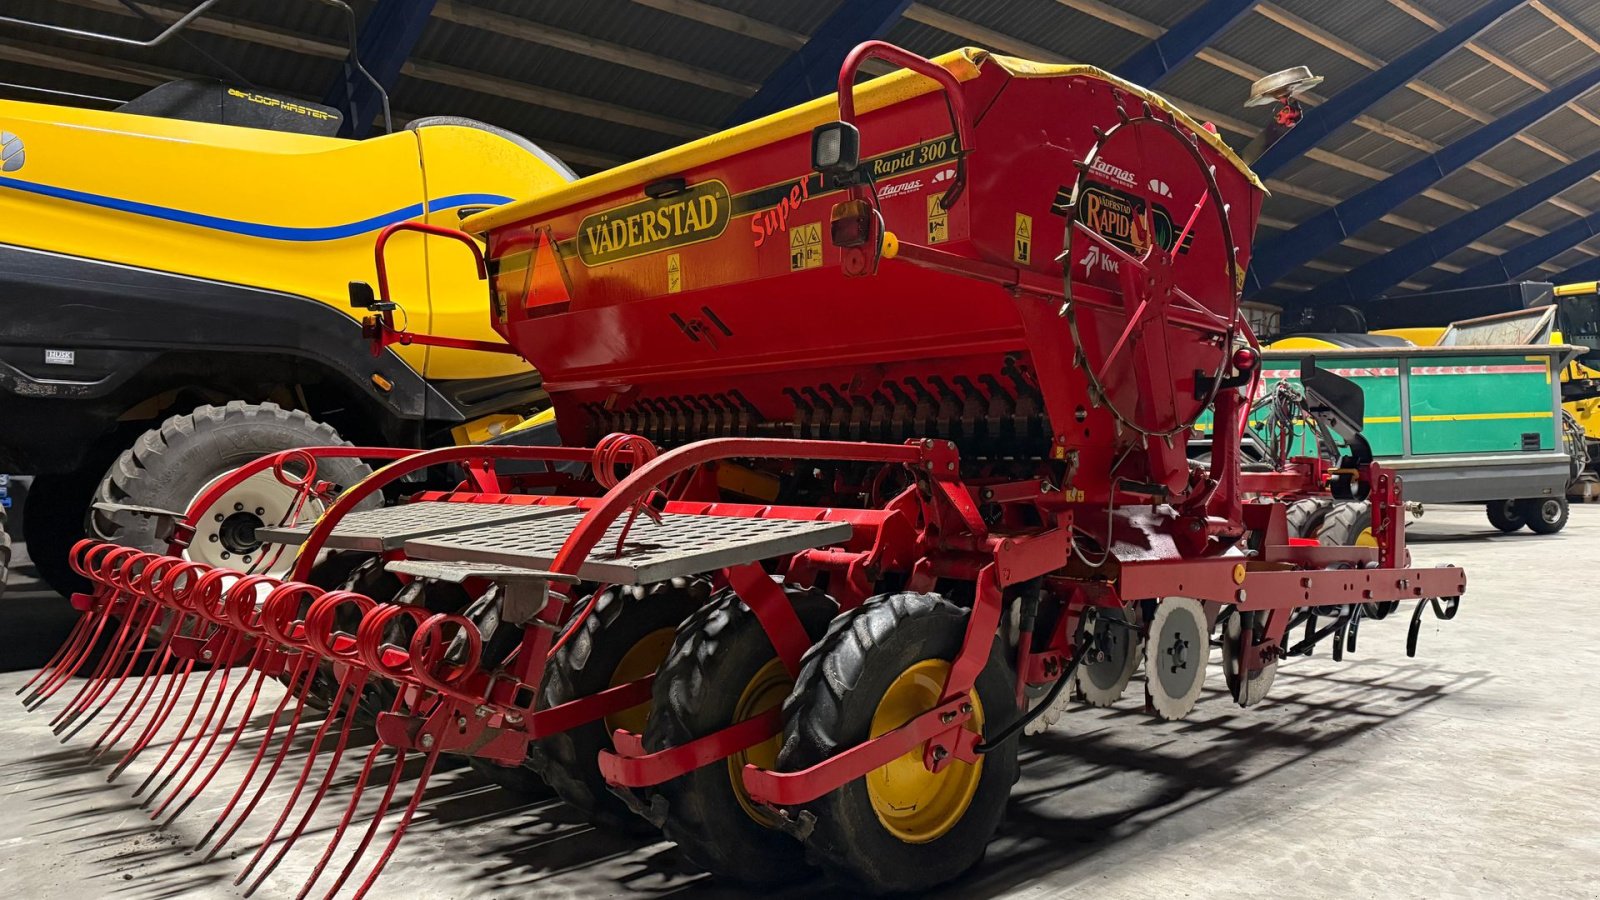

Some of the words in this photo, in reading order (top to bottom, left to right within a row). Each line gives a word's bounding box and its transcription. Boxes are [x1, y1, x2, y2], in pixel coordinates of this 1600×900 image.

[873, 151, 915, 175] Rapid
[919, 140, 947, 164] 300
[586, 194, 719, 256] VÄDERSTAD
[751, 174, 809, 248] Super
[1086, 192, 1130, 238] RAPID
